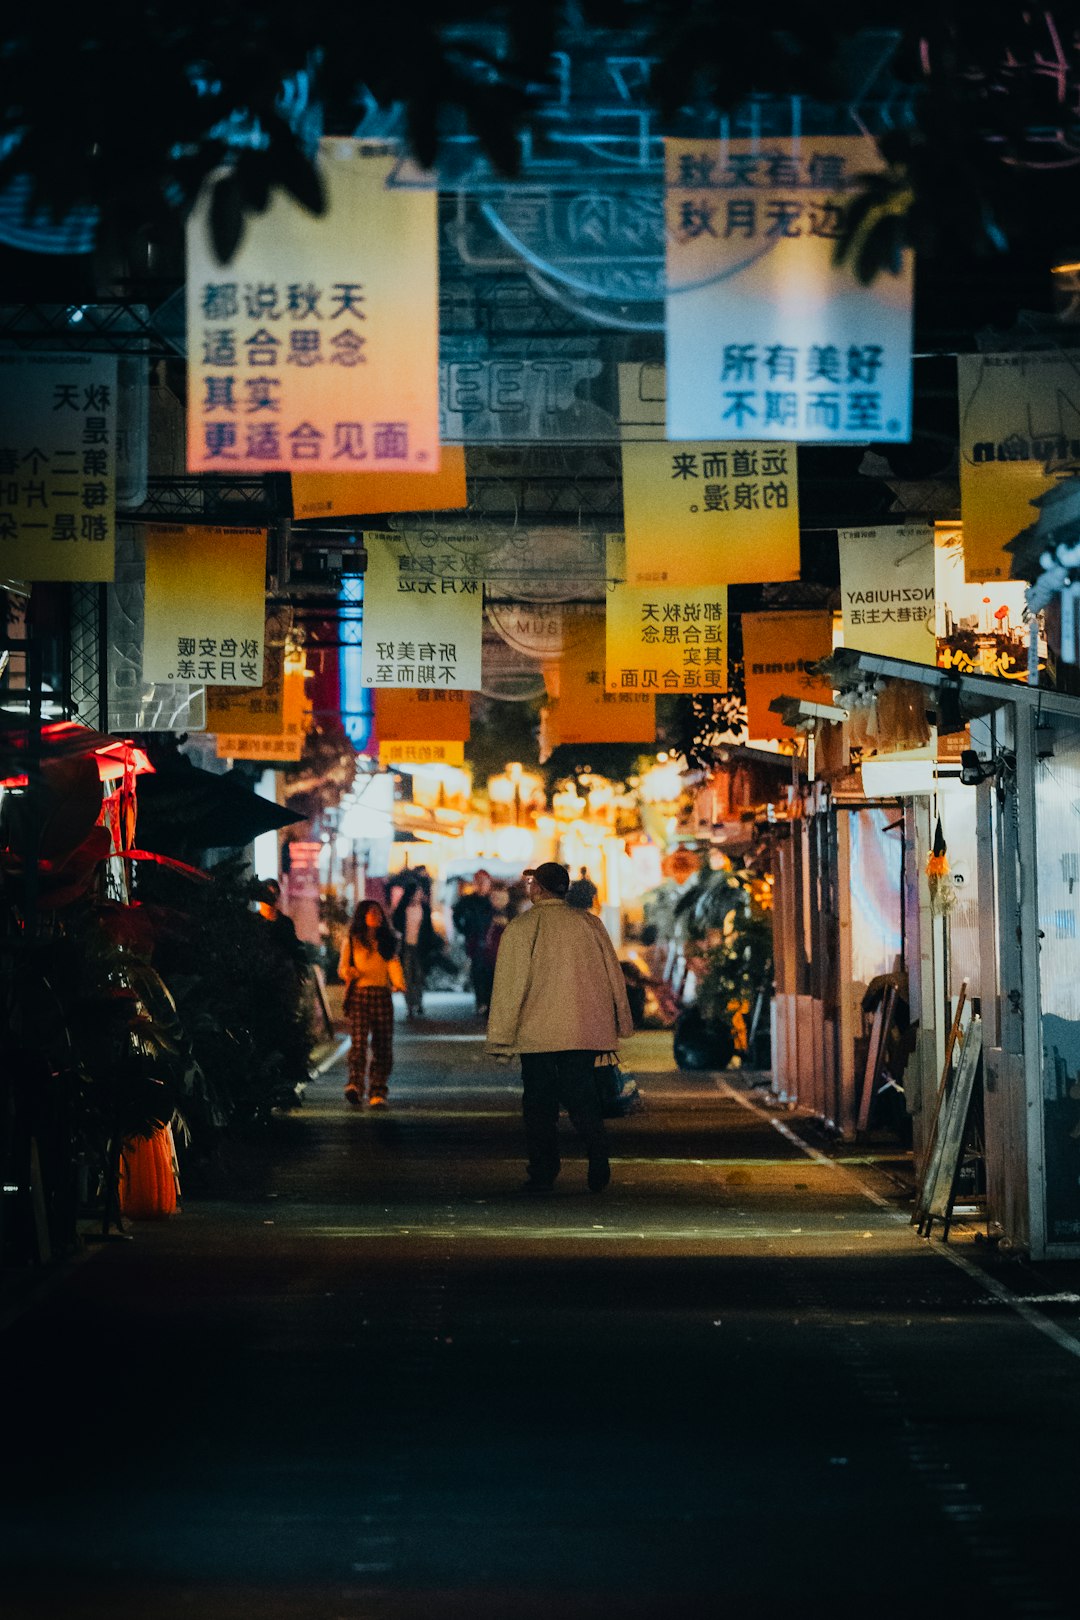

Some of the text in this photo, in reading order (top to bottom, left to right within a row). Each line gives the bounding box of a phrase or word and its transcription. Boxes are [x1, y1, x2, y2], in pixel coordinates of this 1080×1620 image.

[201, 281, 367, 321] 都说秋天
[201, 328, 367, 367] 适合思念
[720, 343, 884, 384] 所有美好
[202, 375, 282, 413] 其实
[722, 390, 902, 432] 不期而至。
[203, 421, 428, 462] 更适合见面。
